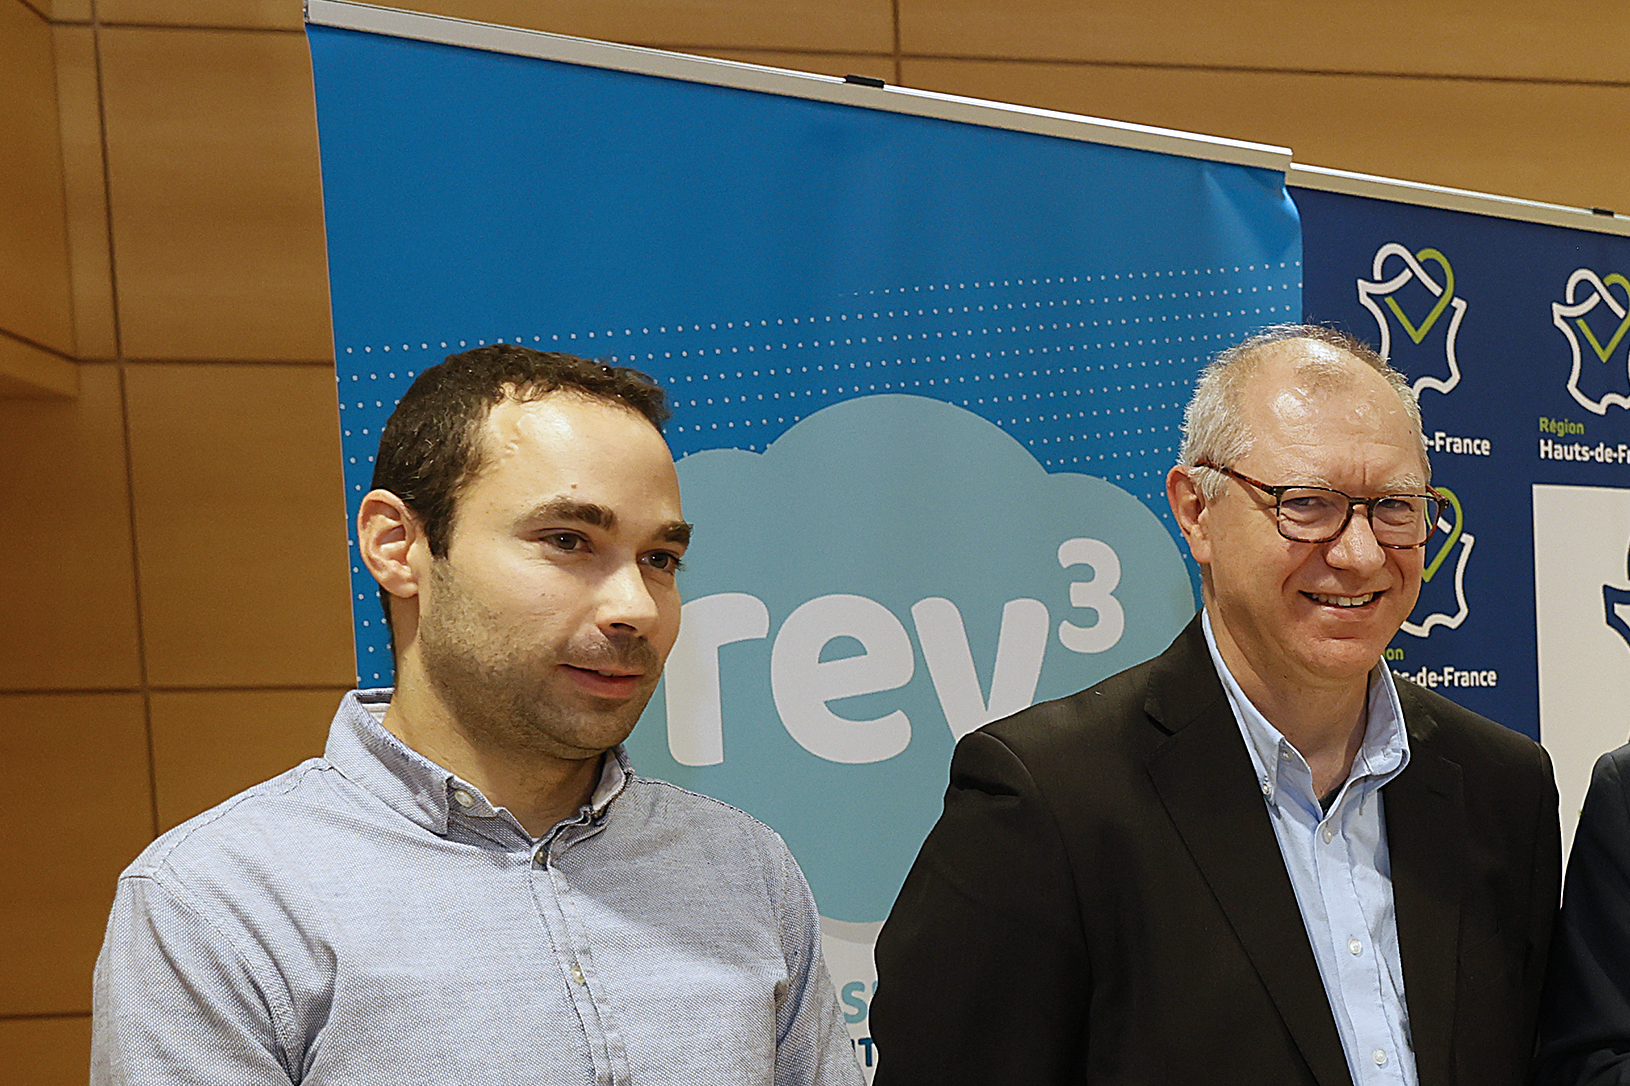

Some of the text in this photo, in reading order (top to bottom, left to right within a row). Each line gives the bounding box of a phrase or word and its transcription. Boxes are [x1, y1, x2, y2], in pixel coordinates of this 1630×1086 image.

[1539, 417, 1585, 437] Région
[1422, 432, 1491, 456] -France
[1393, 666, 1497, 688] -de-France
